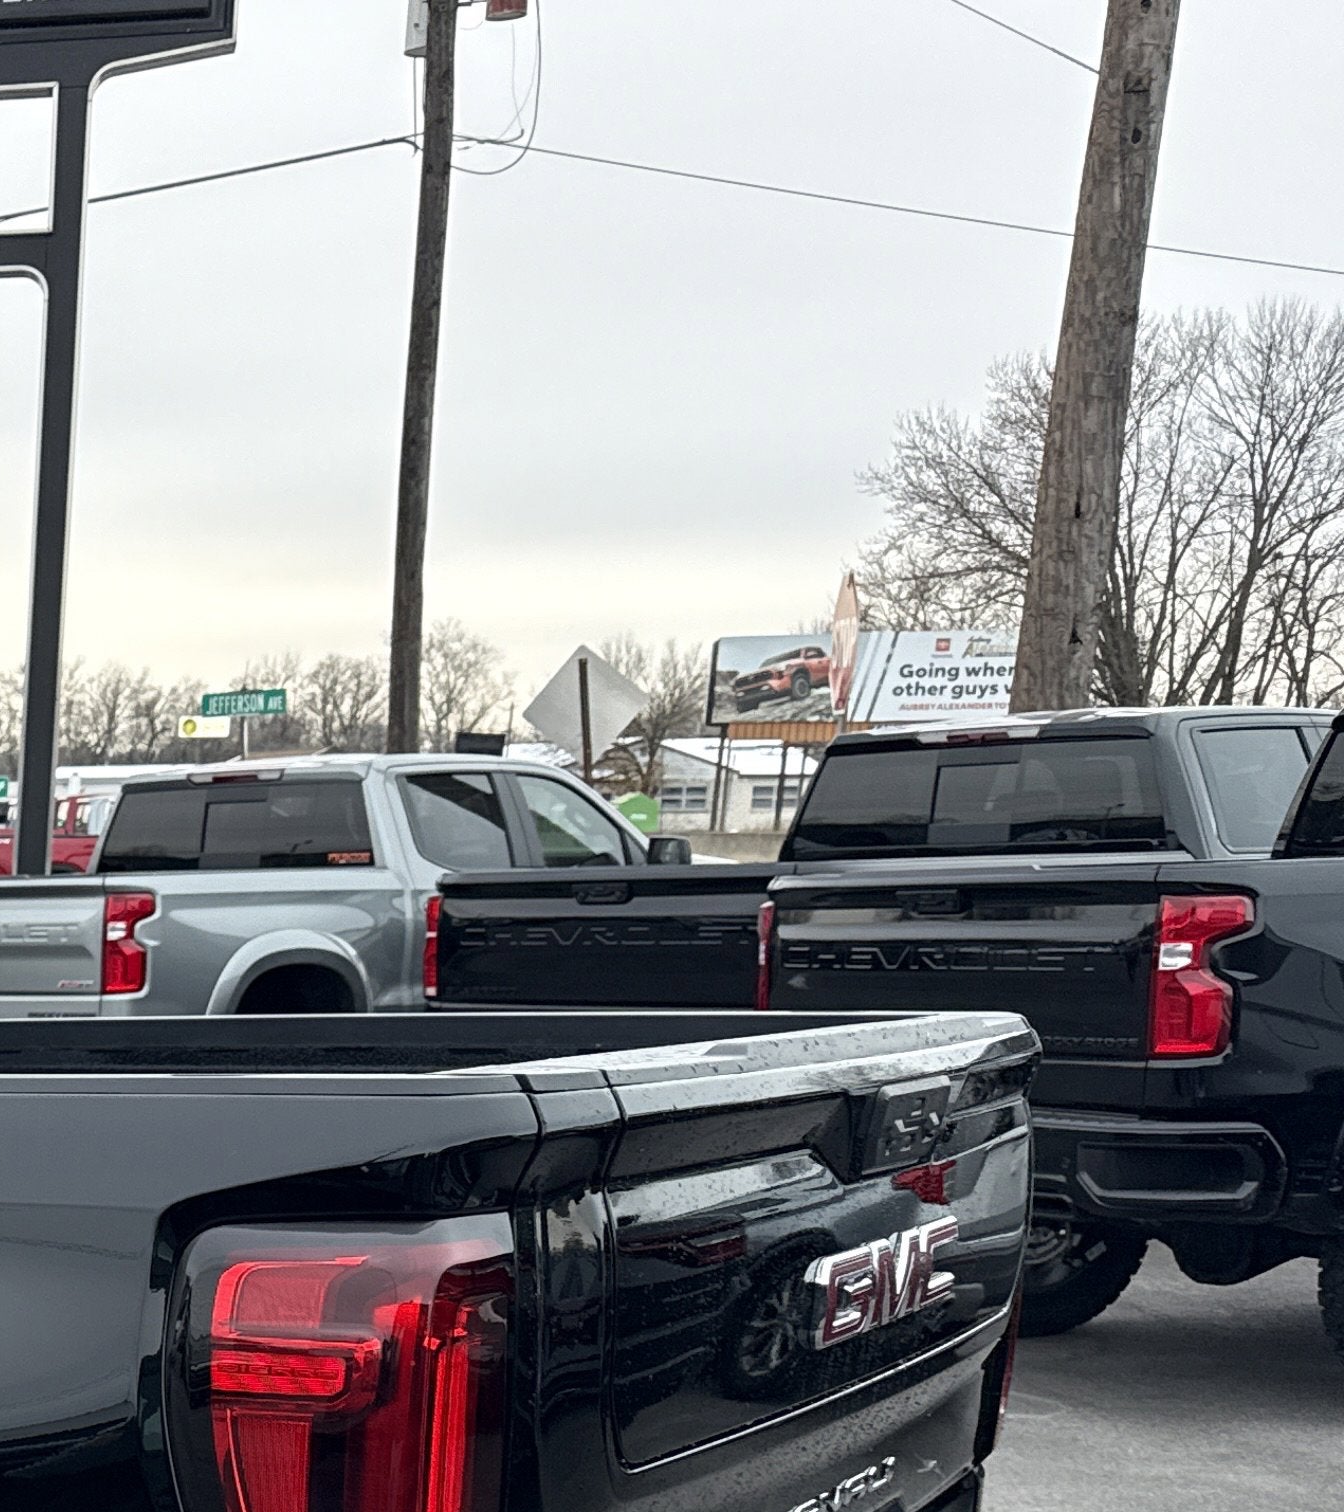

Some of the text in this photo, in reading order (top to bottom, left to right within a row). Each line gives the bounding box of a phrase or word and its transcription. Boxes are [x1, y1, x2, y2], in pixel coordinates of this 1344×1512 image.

[899, 662, 1016, 681] Going wher
[892, 681, 947, 697] other
[950, 684, 999, 699] guys
[206, 694, 283, 715] JEFFERSON AVE
[937, 702, 993, 710] ALEXANDER
[783, 945, 1113, 972] CHEVROLET
[804, 1214, 959, 1350] GMC
